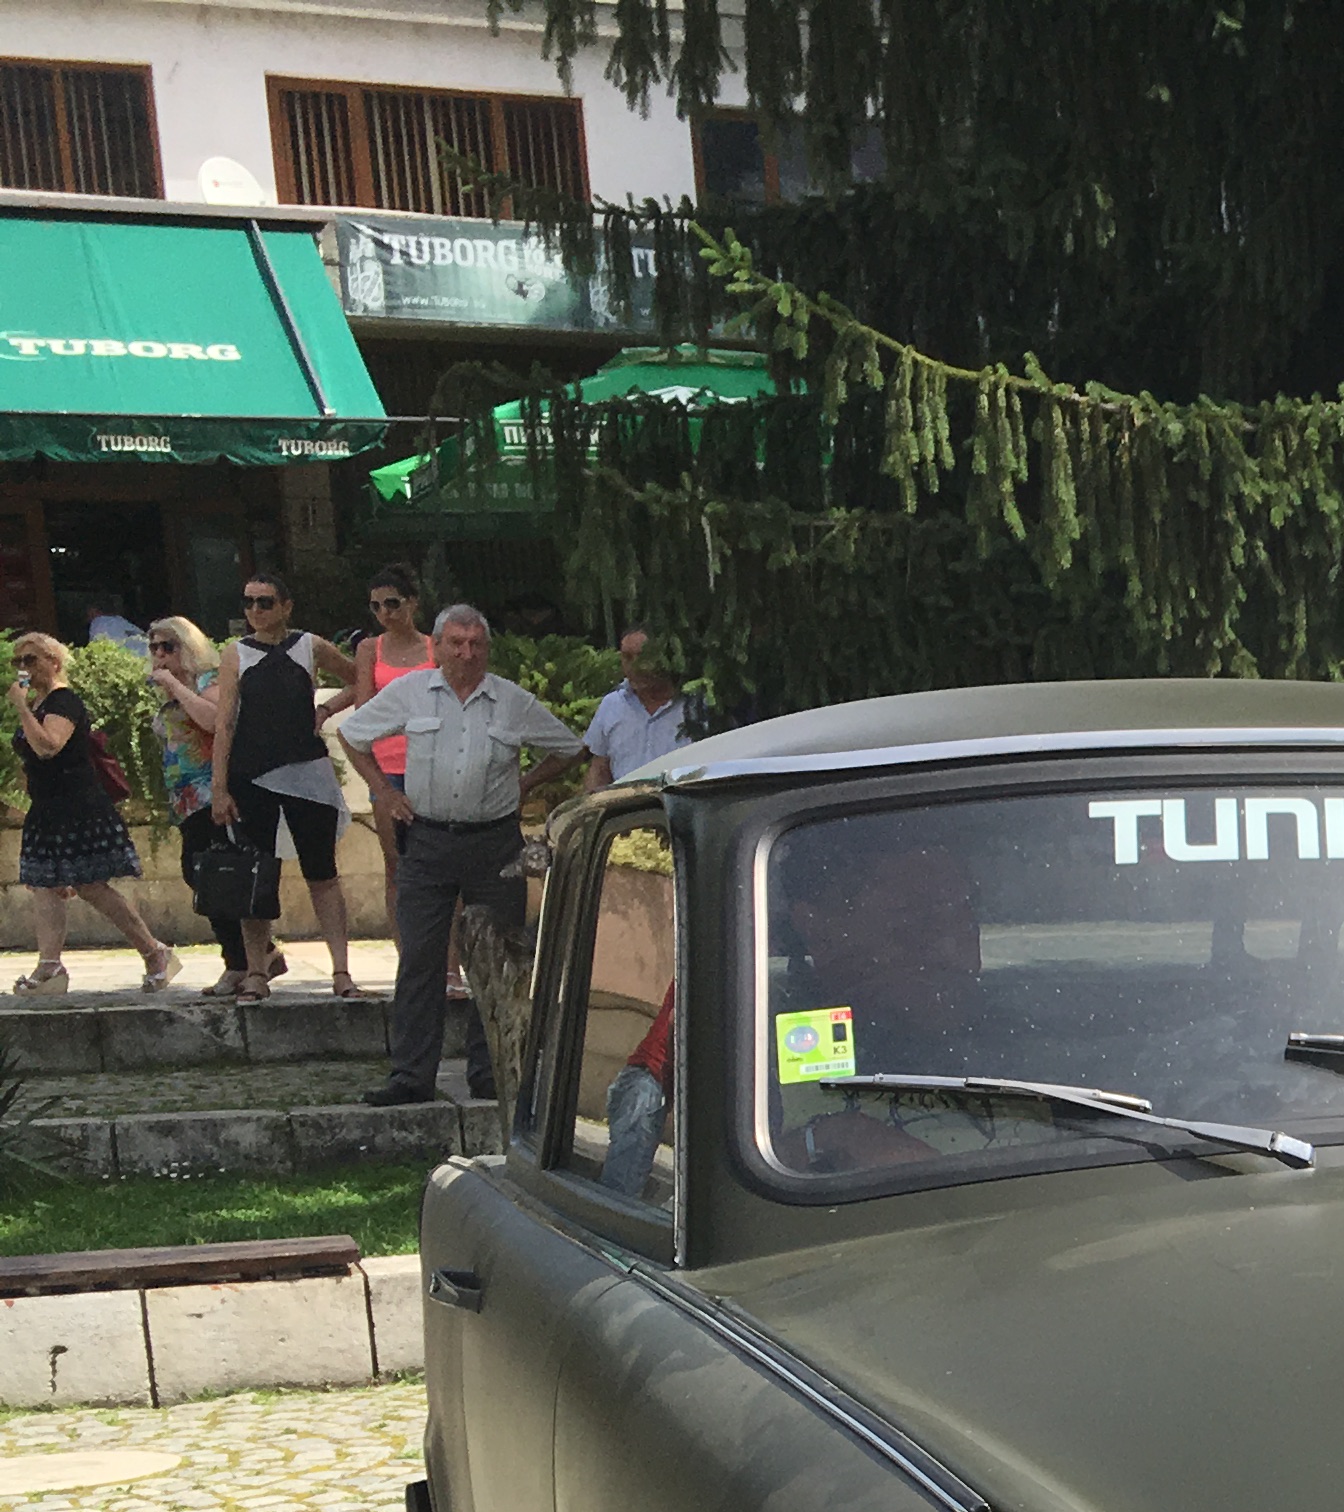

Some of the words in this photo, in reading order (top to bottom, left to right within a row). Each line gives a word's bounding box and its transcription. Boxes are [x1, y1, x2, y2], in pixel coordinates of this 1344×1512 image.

[382, 232, 519, 272] TUBORG
[8, 336, 242, 361] TUBORG
[96, 434, 172, 453] TUBORG
[278, 437, 350, 457] TUBORG
